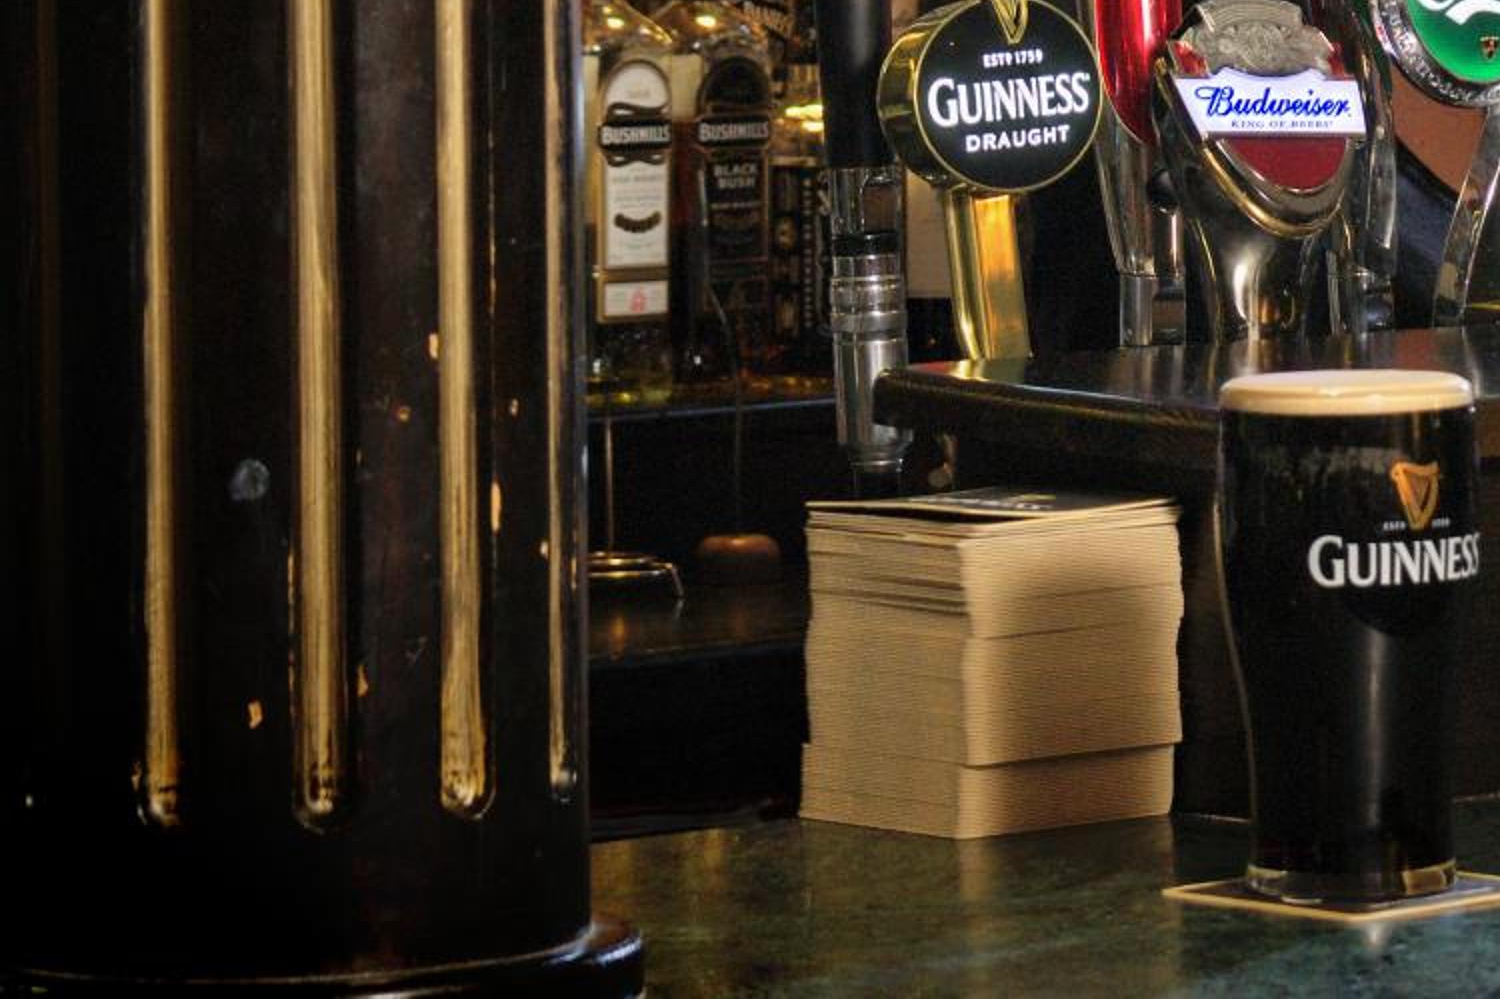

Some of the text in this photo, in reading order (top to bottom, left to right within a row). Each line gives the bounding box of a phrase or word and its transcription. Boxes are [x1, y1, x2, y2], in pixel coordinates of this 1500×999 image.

[1014, 48, 1044, 66] 1759
[927, 72, 1090, 128] GUINNESS
[1194, 86, 1351, 118] Budweiser
[699, 122, 769, 143] BUSHMILLS
[1231, 119, 1332, 129] KING OF BEERS
[601, 125, 670, 145] BUSHMILLS
[965, 125, 1071, 153] DRAUGHT
[713, 162, 759, 177] BLACK
[717, 175, 756, 190] BUSH
[1307, 531, 1481, 589] GUINNESS
